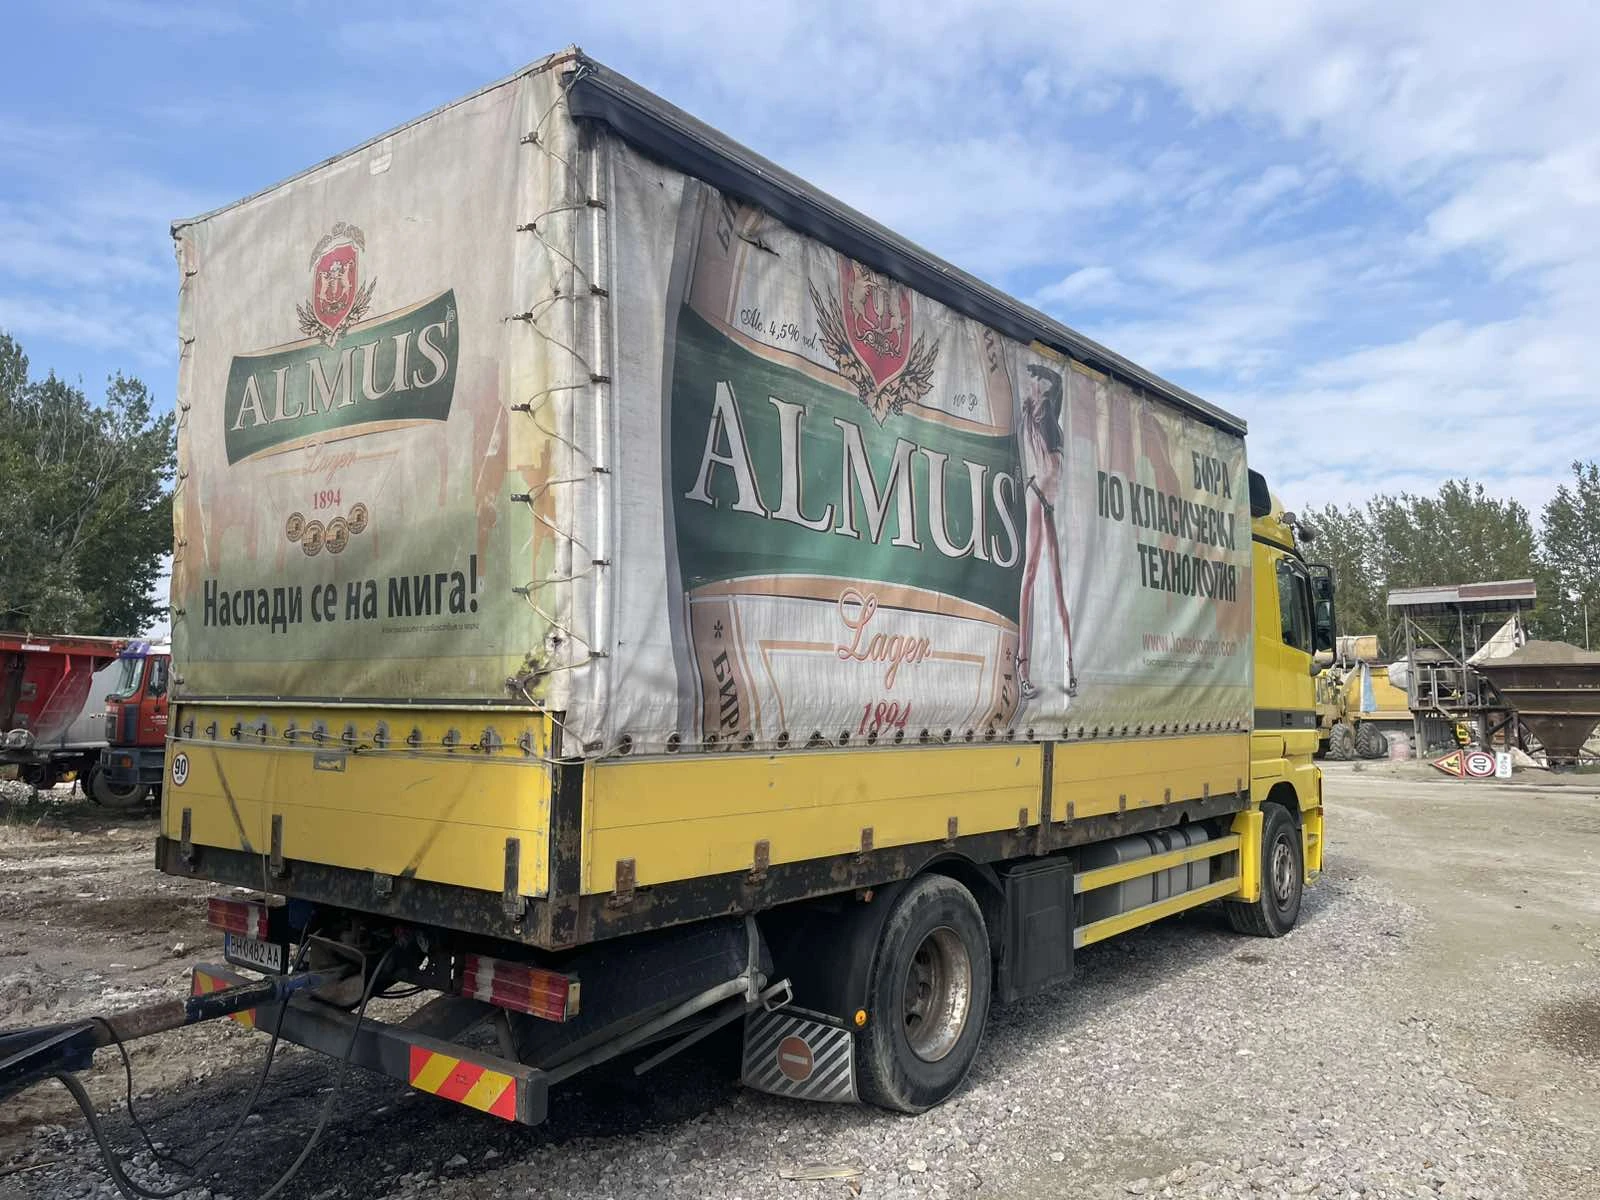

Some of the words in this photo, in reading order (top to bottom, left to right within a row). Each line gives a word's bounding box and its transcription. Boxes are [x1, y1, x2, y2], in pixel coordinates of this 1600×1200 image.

[769, 320, 800, 342] 4,5%
[230, 321, 449, 432] ALMUS
[313, 488, 342, 510] 1894
[684, 380, 1020, 569] ALMUS
[1097, 470, 1124, 522] ПО
[1192, 450, 1232, 499] БИРА
[203, 579, 303, 633] Наслади
[311, 582, 338, 622] се
[345, 579, 378, 620] на
[388, 554, 478, 618] мига!
[1137, 542, 1236, 602] ТЕХНОЛОГИЯ
[838, 587, 930, 690] Lager
[858, 700, 911, 737] 1894
[174, 758, 187, 775] 90
[1472, 757, 1487, 771] 40
